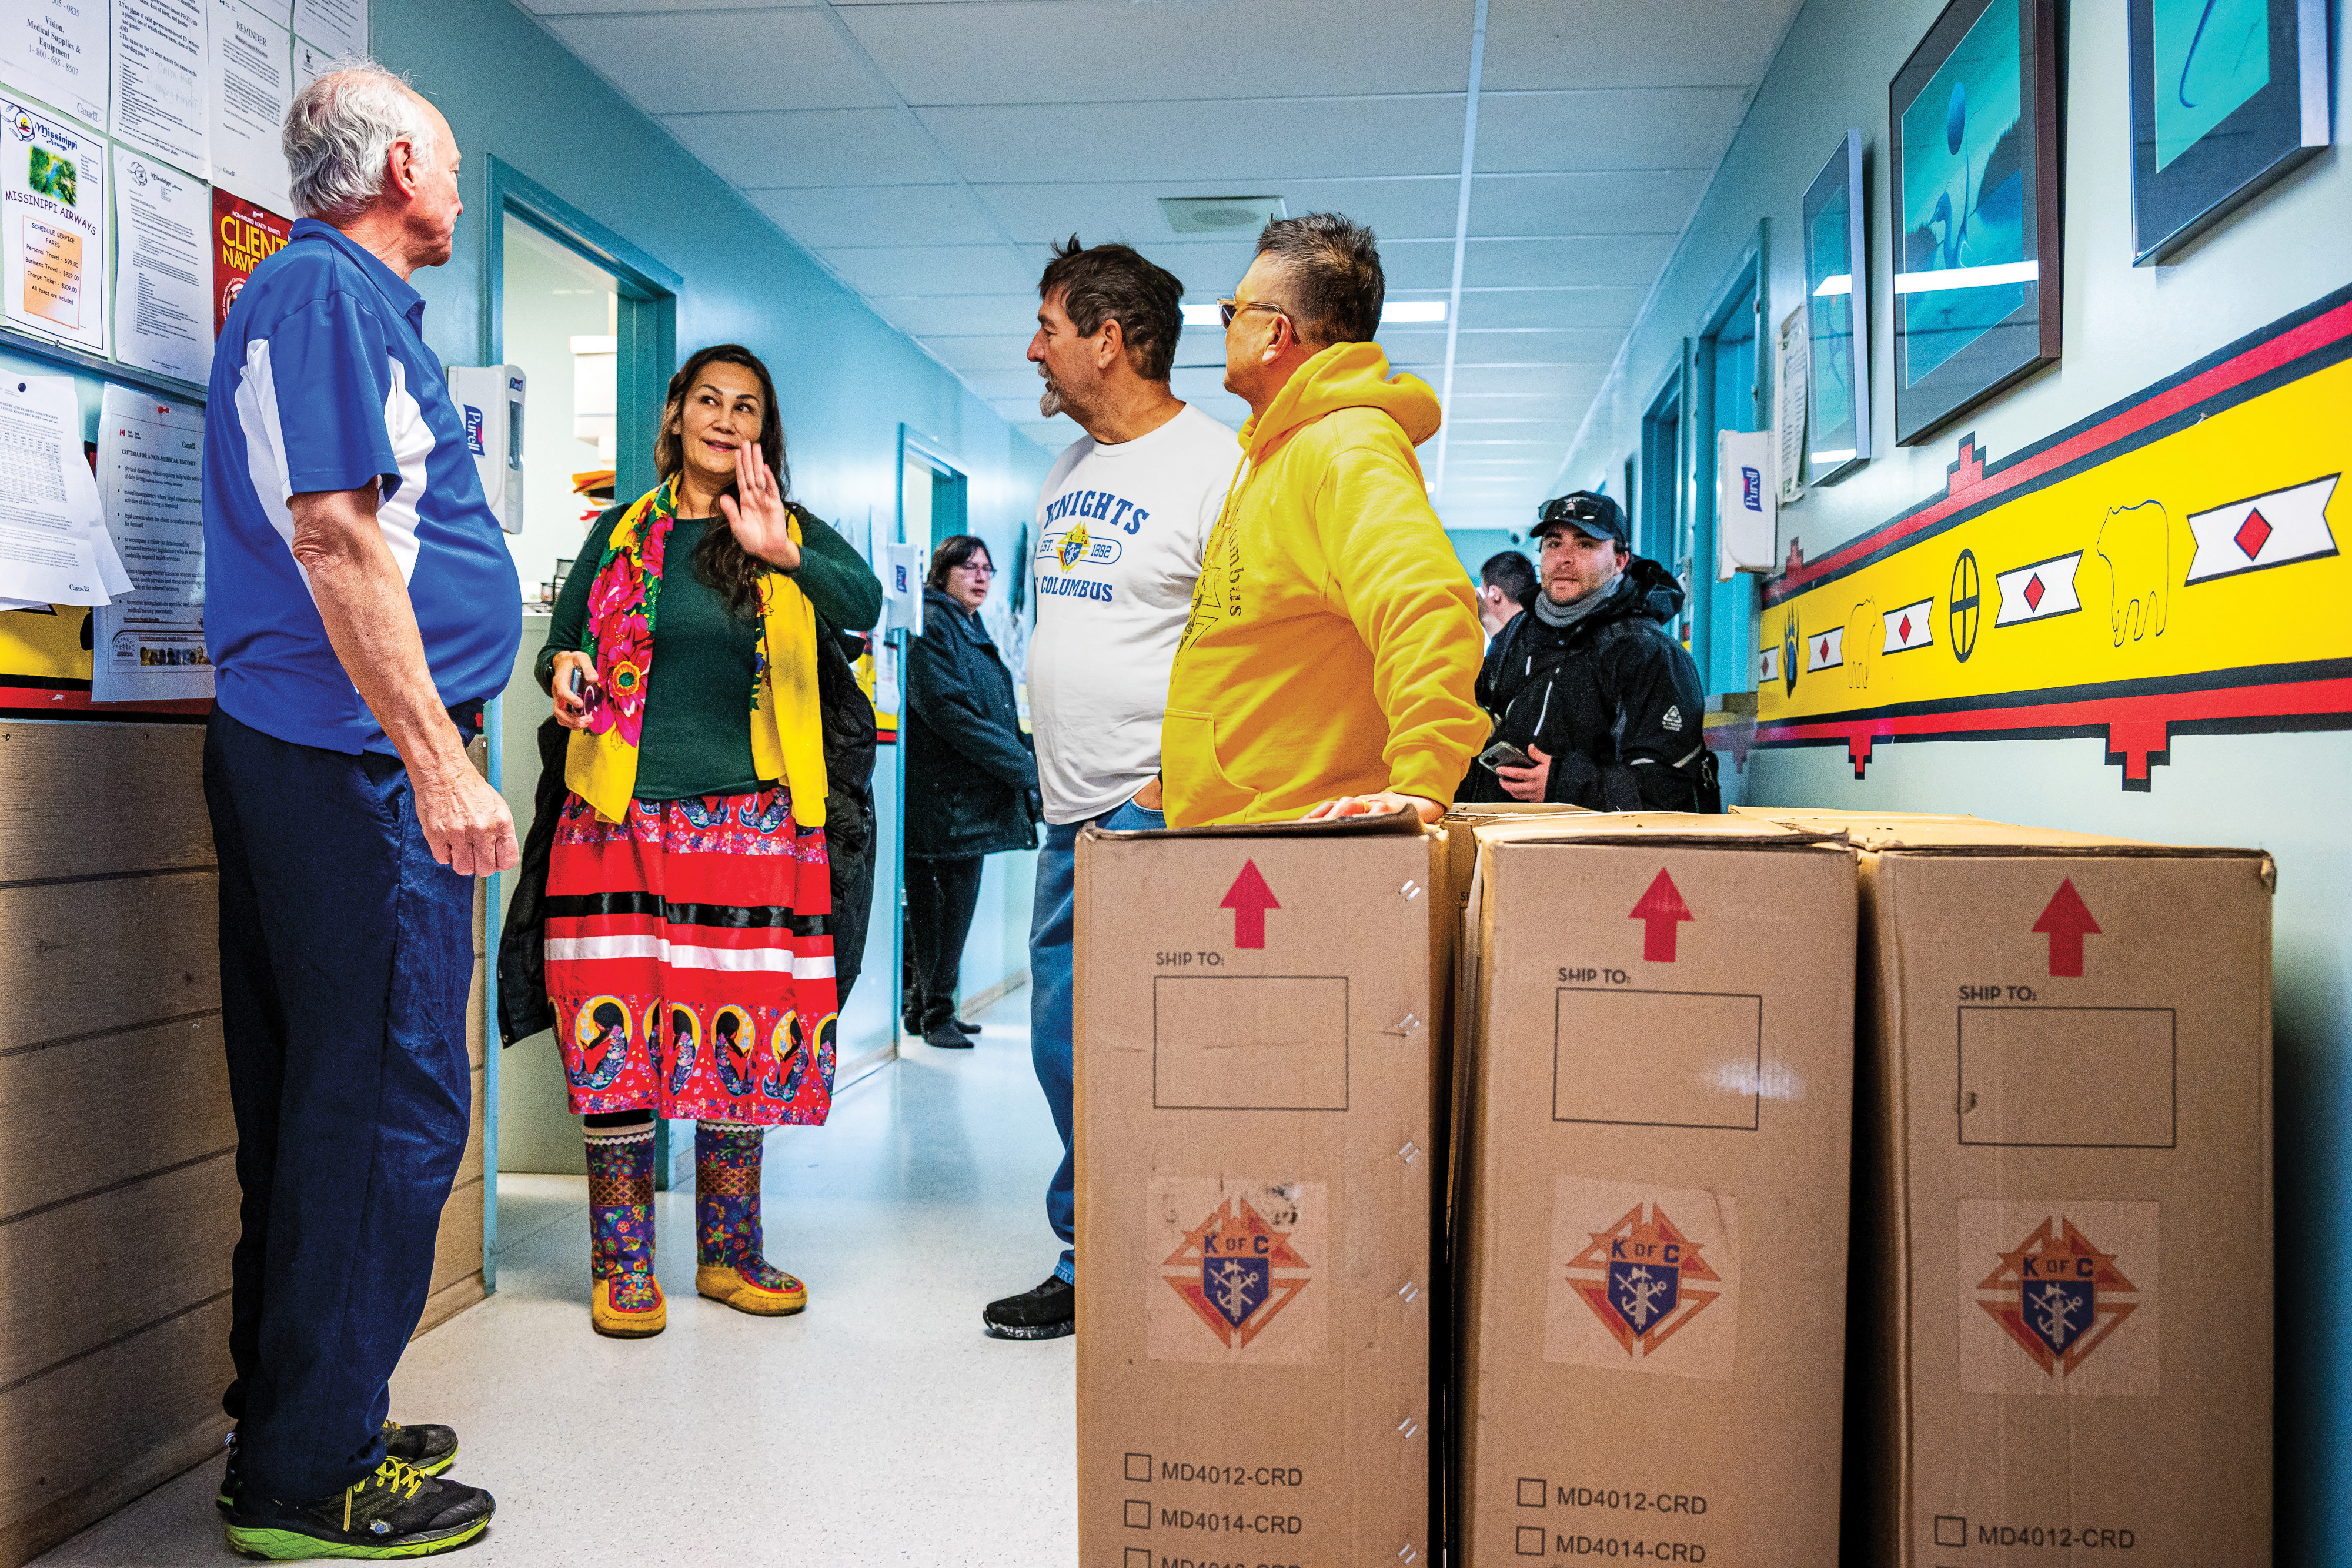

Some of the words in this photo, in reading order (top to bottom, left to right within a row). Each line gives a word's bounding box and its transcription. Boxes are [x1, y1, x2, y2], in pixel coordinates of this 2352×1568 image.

[67, 5, 79, 17] 0835
[181, 12, 193, 24] PHOTO
[45, 16, 64, 33] Vision,
[236, 21, 266, 47] REMINDER
[27, 19, 49, 36] Medical
[51, 31, 74, 51] Supplies
[76, 45, 81, 54] &
[39, 36, 69, 59] Equipment
[122, 41, 137, 54] boarding
[36, 48, 46, 59] 800
[51, 56, 60, 67] 665
[66, 63, 78, 76] 8507
[163, 56, 173, 65] match
[77, 103, 98, 122] Canada
[35, 122, 77, 150] Missinippi
[46, 139, 67, 151] Airways
[159, 144, 170, 152] without
[5, 190, 57, 213] MISSINIPPI
[60, 207, 96, 235] AIRWAYS
[232, 210, 254, 225] NON-INSURED
[255, 221, 266, 230] HEALTH
[268, 226, 281, 236] BENEFITS
[32, 223, 55, 236] SCHEDULE
[57, 233, 75, 244] SERVICE
[46, 238, 62, 248] FARES:
[220, 215, 289, 260] CLIENT
[26, 243, 45, 255] Personal
[46, 251, 59, 260] Travel
[65, 258, 78, 268] $99.00
[25, 257, 44, 268] Business
[45, 263, 58, 273] Travel
[63, 271, 79, 281] $229.00
[28, 270, 42, 280] Charge
[44, 276, 56, 285] Ticket
[61, 283, 77, 293] $309.00
[39, 288, 49, 296] taxes
[59, 296, 74, 305] included
[467, 411, 481, 451] Purell
[122, 449, 139, 457] CRITERIA
[151, 454, 178, 464] NON-MEDICAL
[182, 441, 196, 449] Canada
[1745, 471, 1759, 508] Purell
[1044, 490, 1150, 535] KNIGHTS
[1040, 539, 1053, 553] EST.
[1091, 544, 1112, 559] 1882
[1041, 576, 1112, 602] COLUMBUS
[1156, 951, 1192, 967] SHIP
[1197, 951, 1226, 967] TO:
[1558, 967, 1597, 983] SHIP
[1602, 969, 1631, 984] TO:
[1959, 985, 2001, 1001] SHIP
[2006, 985, 2037, 1001] TO:
[1205, 1235, 1218, 1253] K
[1225, 1238, 1247, 1251] OF
[1254, 1235, 1269, 1254] C
[1612, 1239, 1626, 1259] K
[1635, 1243, 1656, 1258] OF
[1664, 1245, 1679, 1263] C
[2023, 1256, 2039, 1278] K
[2047, 1259, 2069, 1274] OF
[2077, 1258, 2093, 1278] C
[1162, 1462, 1303, 1486] MD4012-CRD
[1558, 1486, 1706, 1515] MD4012-CRD
[1162, 1509, 1302, 1534] MD4014-CRD
[1556, 1534, 1705, 1563] MD4014-CRD
[1979, 1526, 2134, 1549] MD4012-CRD
